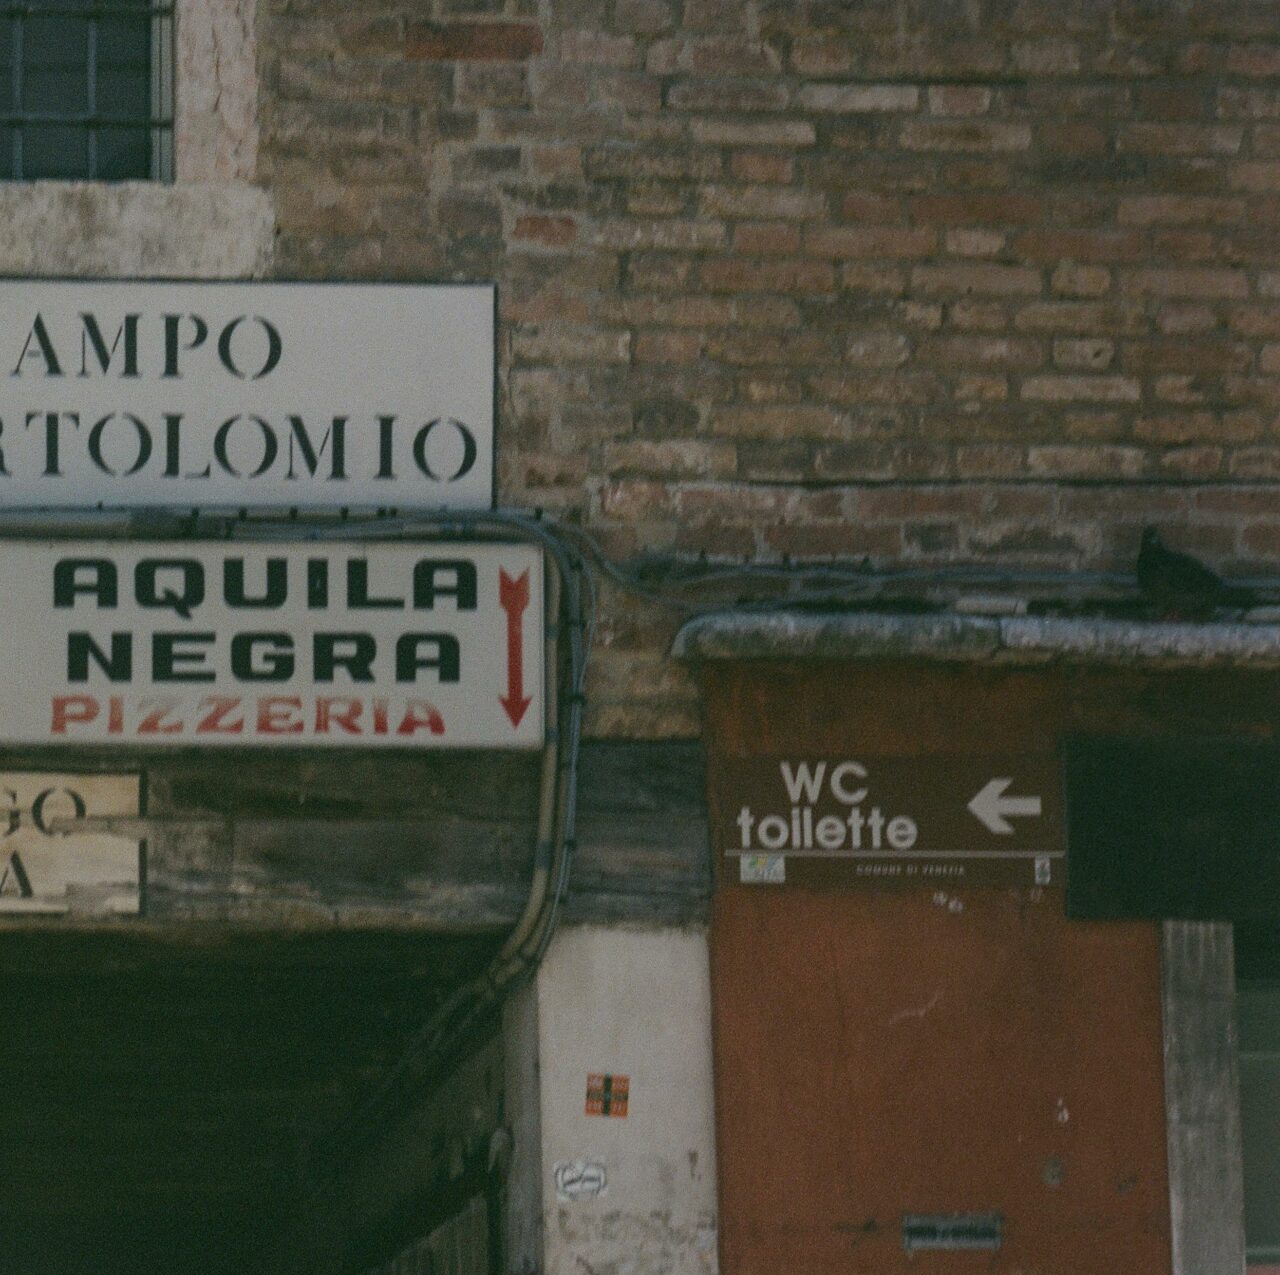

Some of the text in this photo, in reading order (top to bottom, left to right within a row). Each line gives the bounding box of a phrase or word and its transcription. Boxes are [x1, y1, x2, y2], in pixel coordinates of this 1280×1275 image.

[52, 557, 478, 619] AQUILA
[66, 630, 461, 683] NEGRA
[49, 695, 446, 735] PIZZERIA
[779, 760, 869, 805] WC
[736, 805, 919, 850] toilette
